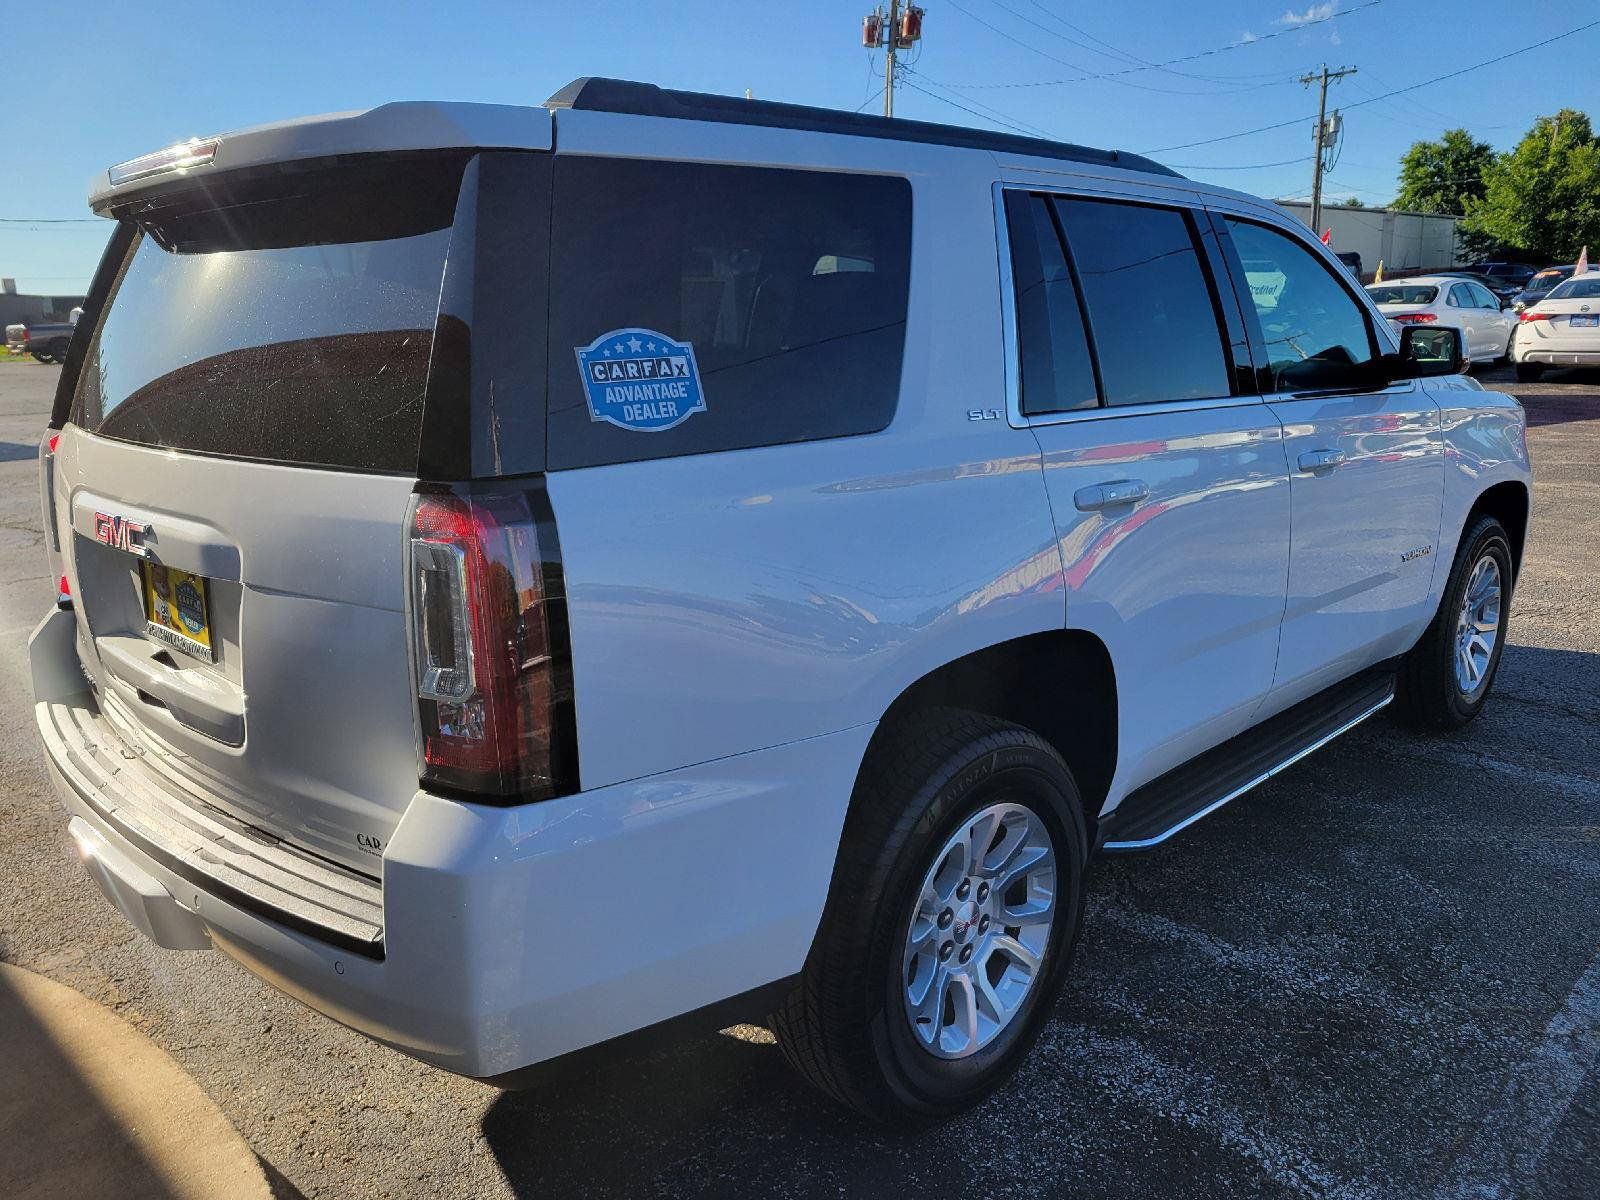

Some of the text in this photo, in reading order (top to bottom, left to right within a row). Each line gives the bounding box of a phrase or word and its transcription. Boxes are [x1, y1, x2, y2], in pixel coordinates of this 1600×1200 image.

[592, 359, 688, 381] CARFAX
[605, 383, 689, 403] ADVANTAGE
[623, 402, 679, 422] DEALER
[967, 409, 1003, 421] SLT
[95, 511, 149, 558] GMC
[356, 833, 382, 851] CAR
